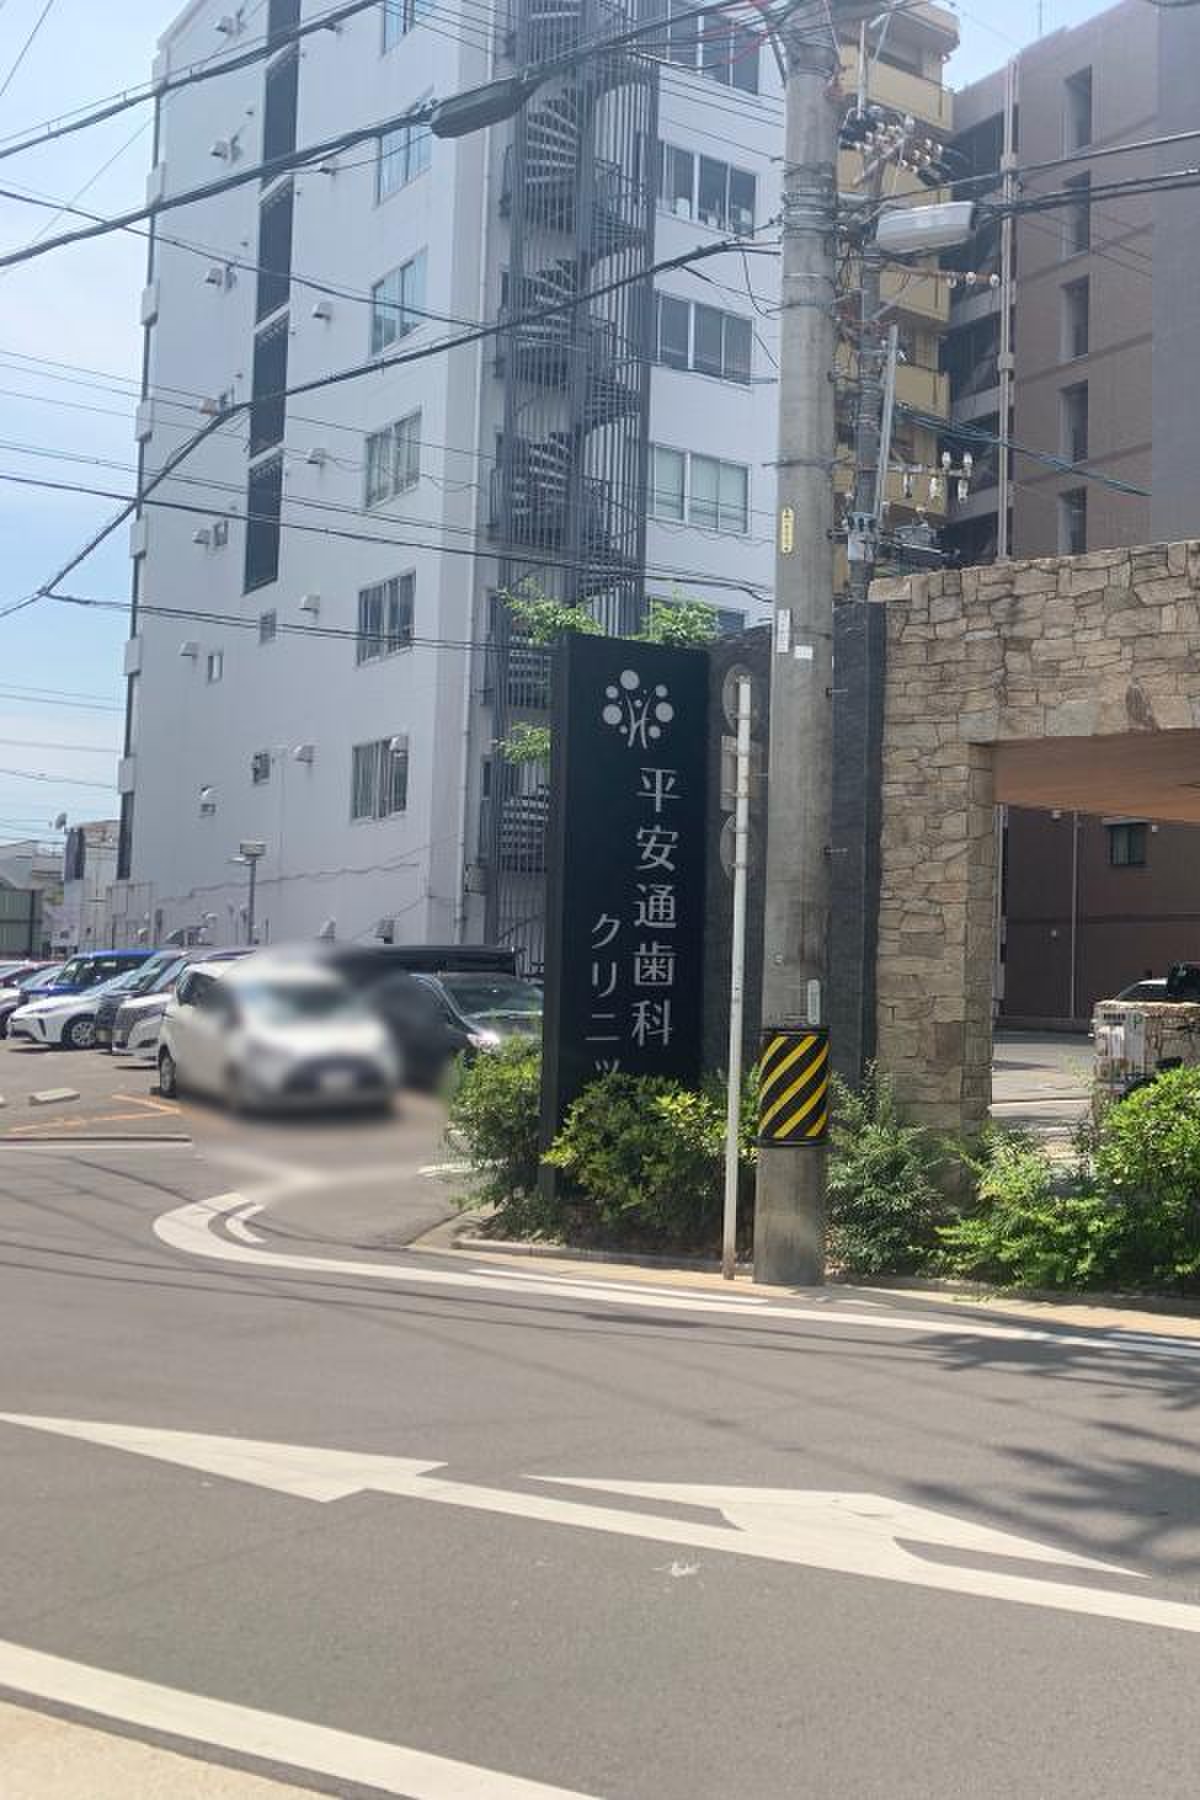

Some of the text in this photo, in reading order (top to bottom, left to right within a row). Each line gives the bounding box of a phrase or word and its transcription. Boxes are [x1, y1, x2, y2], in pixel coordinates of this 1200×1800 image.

[632, 767, 682, 1047] 平安通歯科
